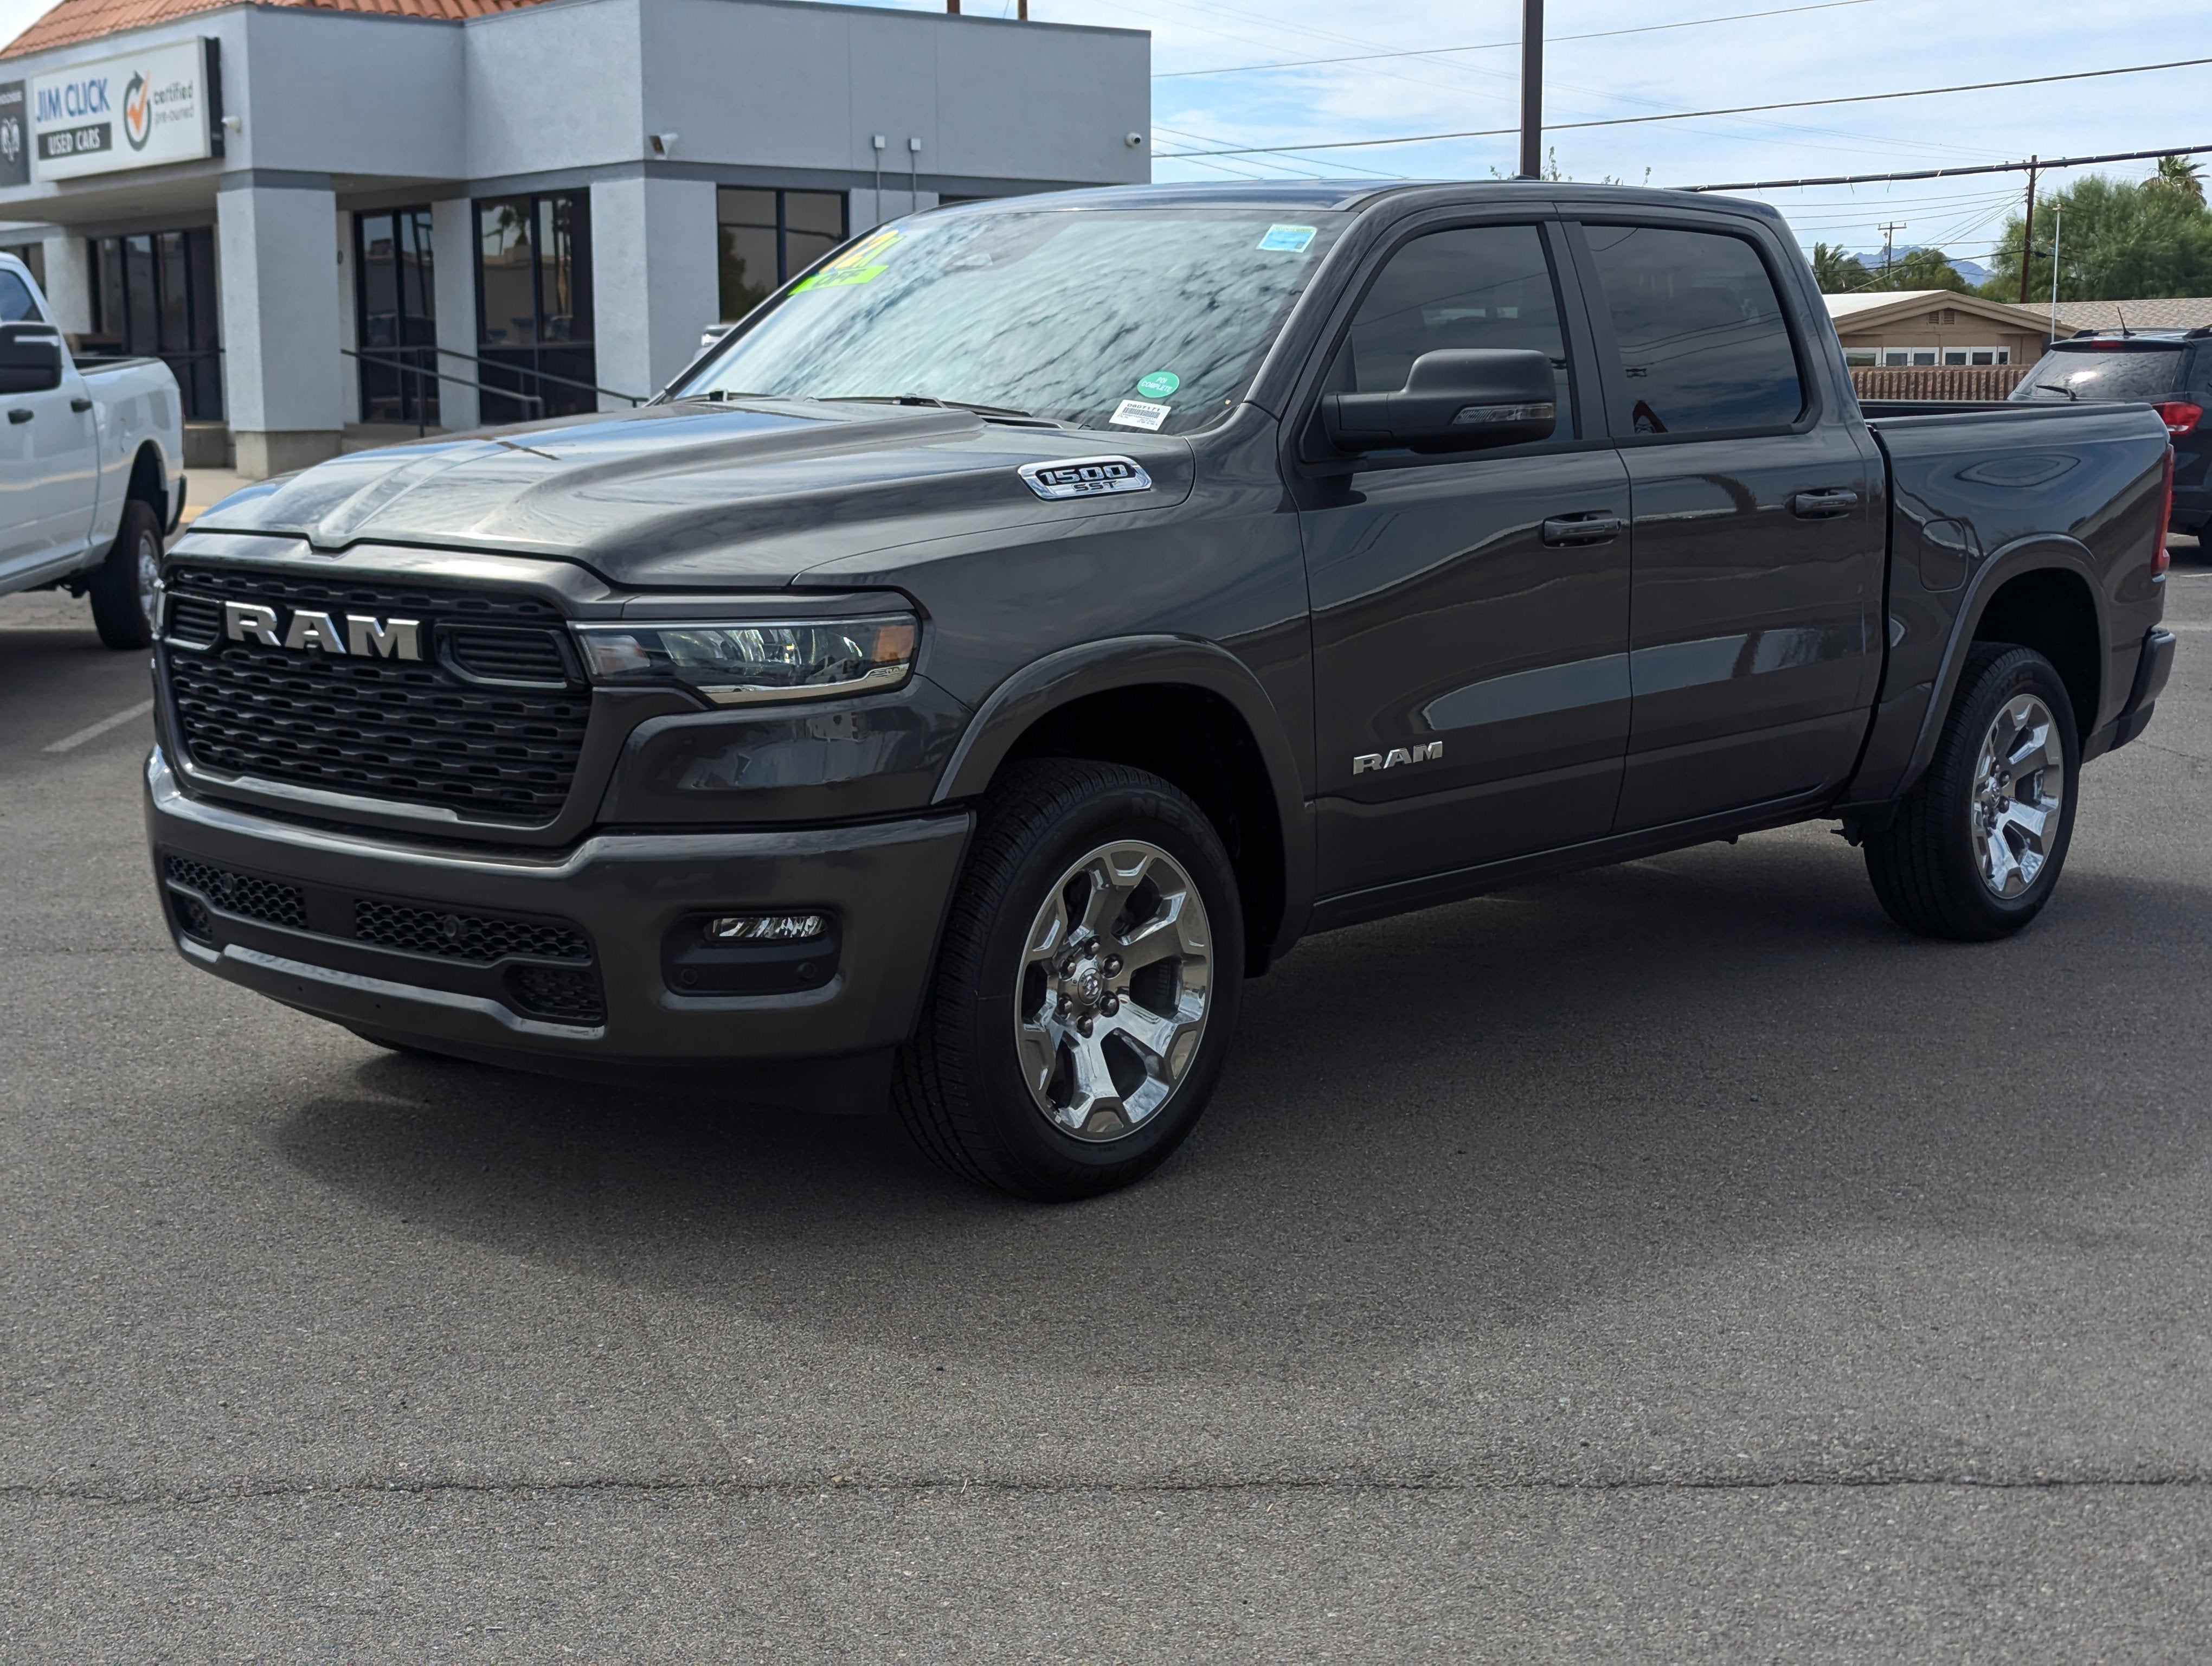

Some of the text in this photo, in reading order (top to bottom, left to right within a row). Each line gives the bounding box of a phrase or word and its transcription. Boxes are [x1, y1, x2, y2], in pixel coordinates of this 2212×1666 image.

[36, 78, 111, 123] JIM CLICK
[154, 79, 194, 105] certified
[48, 126, 100, 155] USED CARS
[1040, 464, 1128, 485] 1500
[225, 600, 423, 661] RAM
[1353, 741, 1443, 775] RAM
